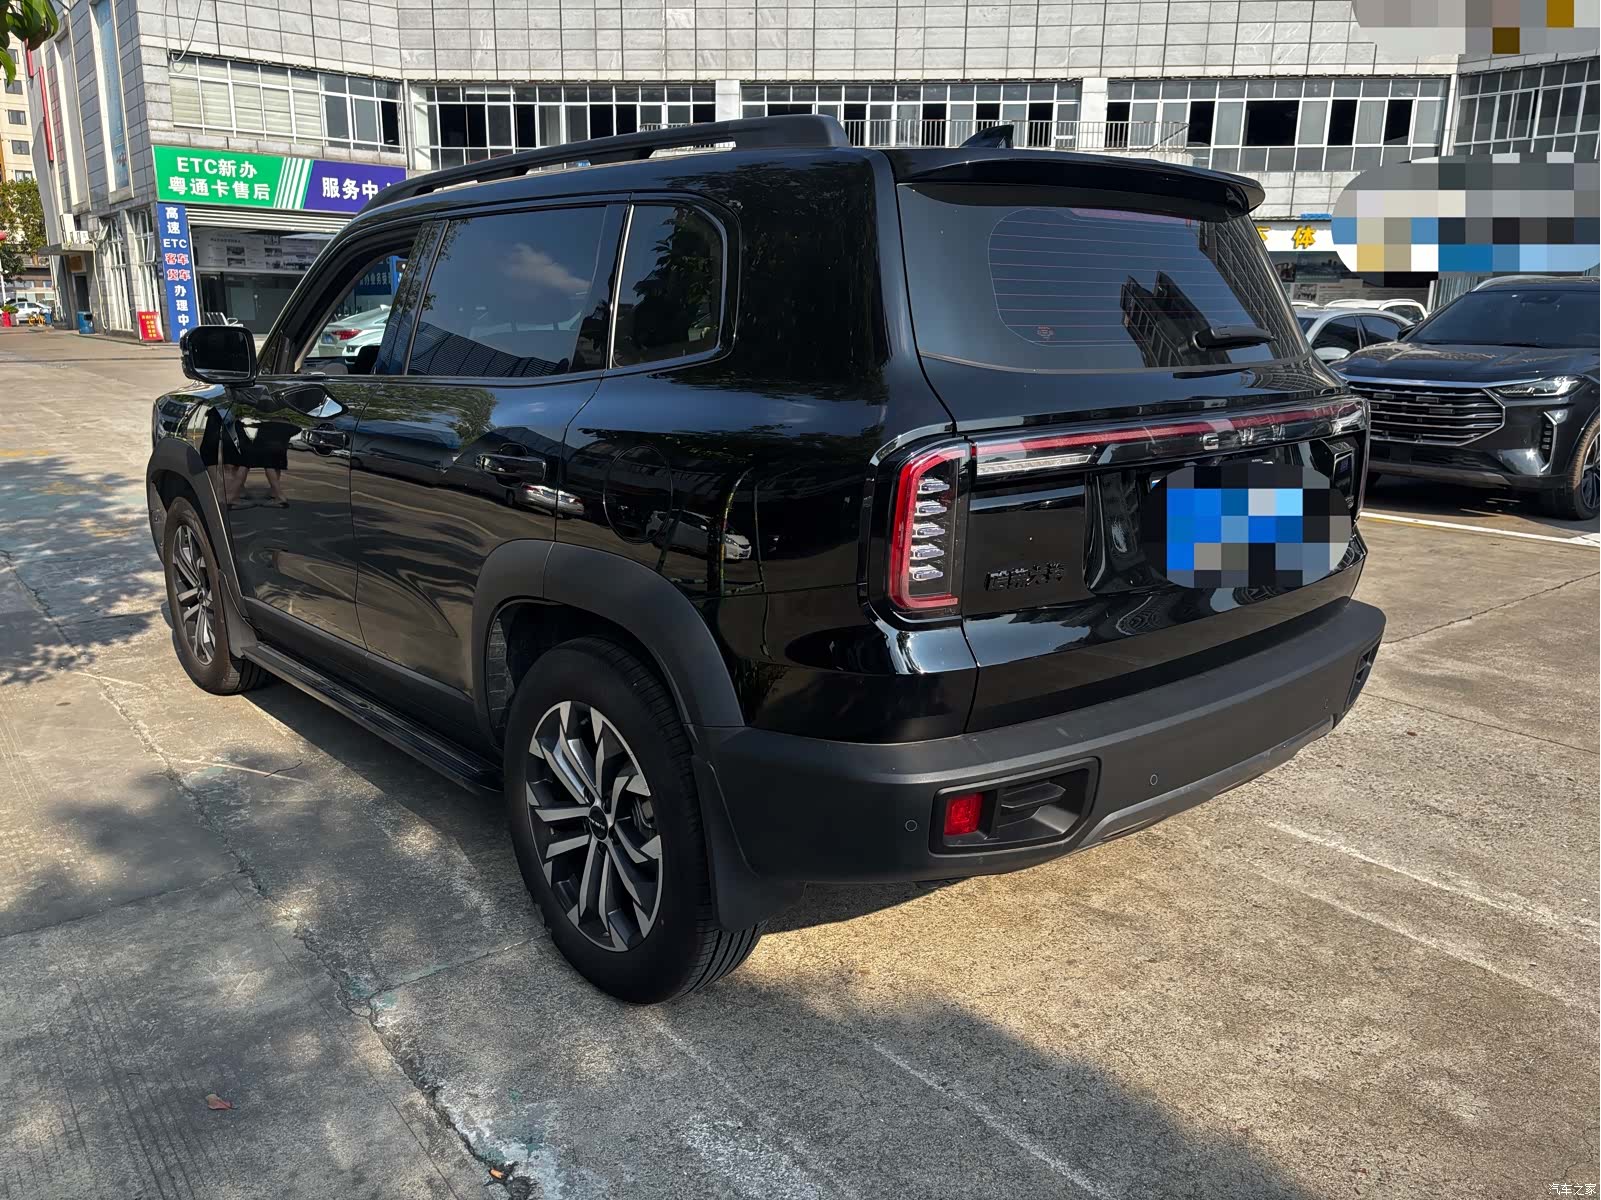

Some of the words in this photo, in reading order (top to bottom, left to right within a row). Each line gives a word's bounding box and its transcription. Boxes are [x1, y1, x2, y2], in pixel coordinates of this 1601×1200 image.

[176, 156, 258, 179] ETC新办
[168, 176, 271, 201] 粤通卡售后
[322, 177, 391, 200] 服务中
[165, 206, 181, 235] 高速
[163, 238, 188, 249] ETC
